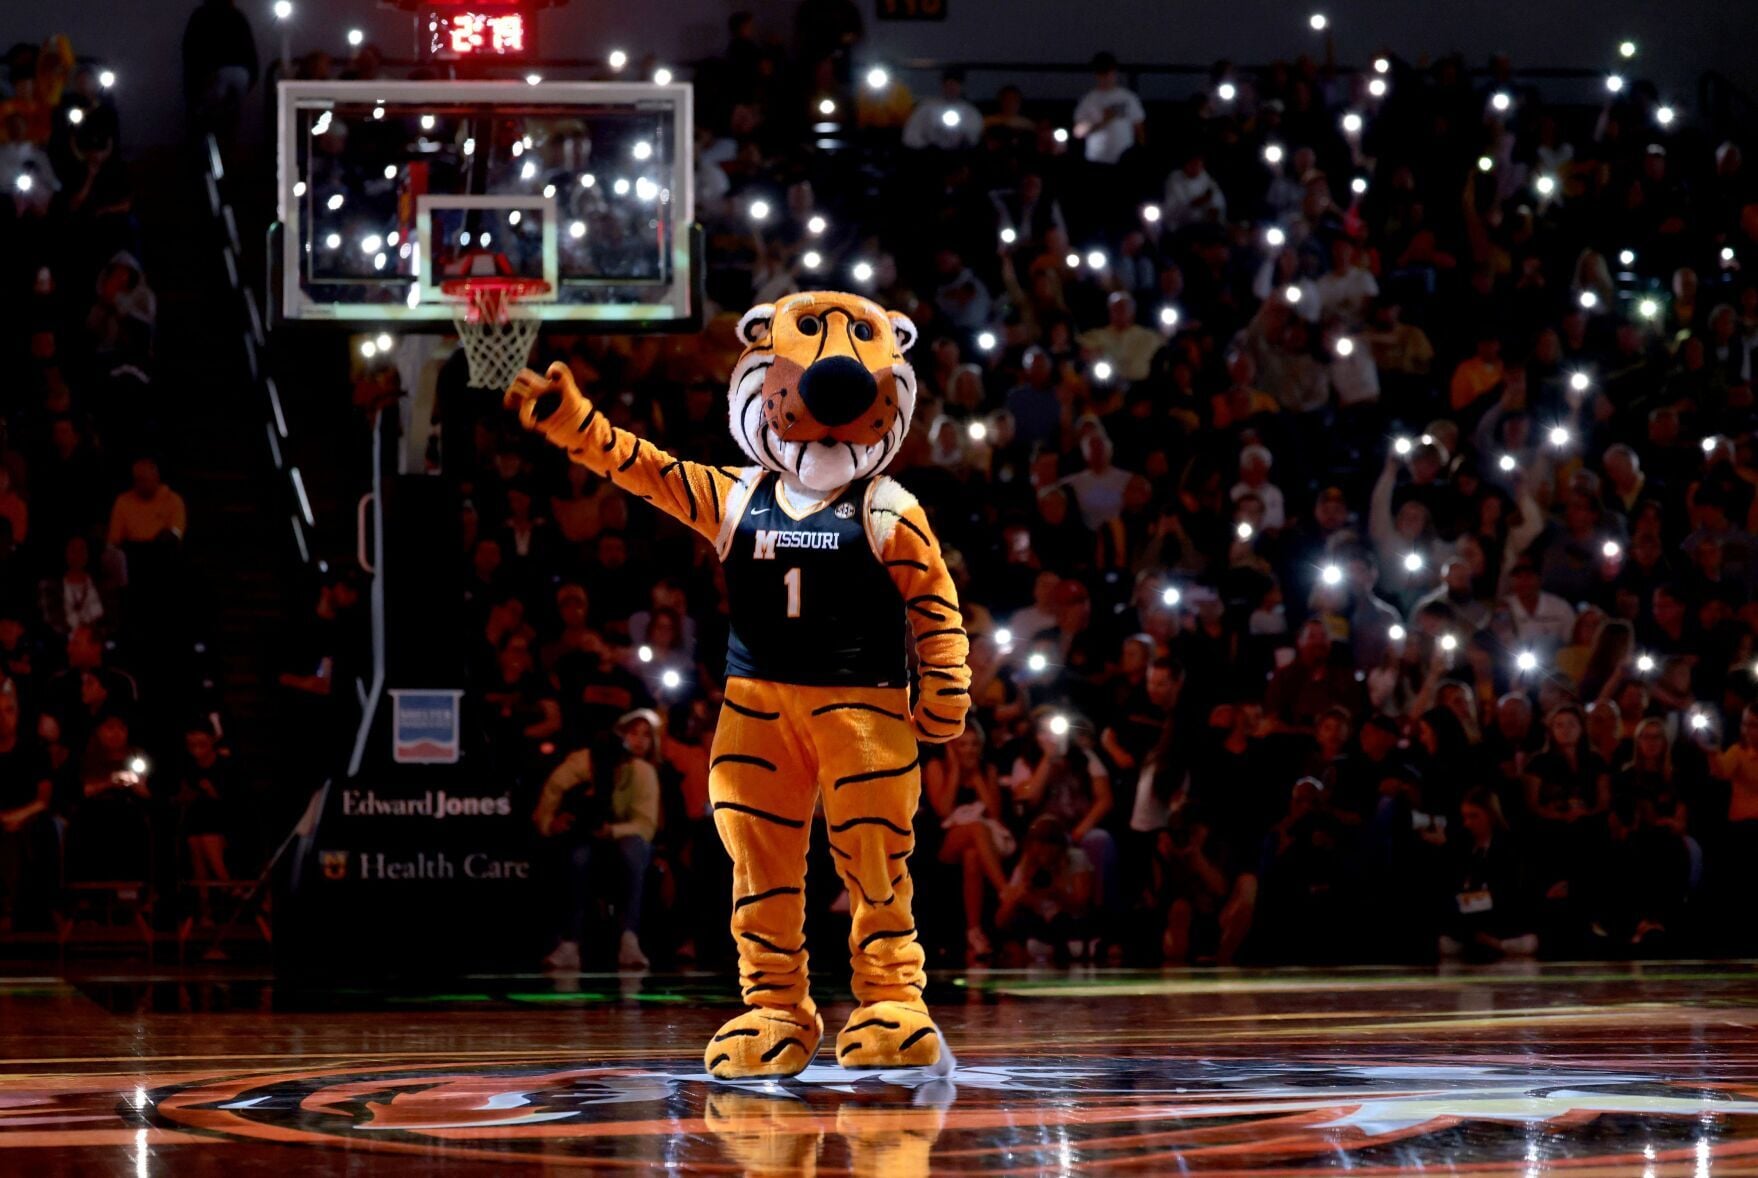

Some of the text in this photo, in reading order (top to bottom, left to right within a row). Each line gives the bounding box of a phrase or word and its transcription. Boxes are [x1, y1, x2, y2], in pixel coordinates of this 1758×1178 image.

[752, 529, 840, 560] MISSOURI
[783, 566, 802, 619] 1
[359, 852, 454, 880] Health
[463, 853, 530, 880] Care
